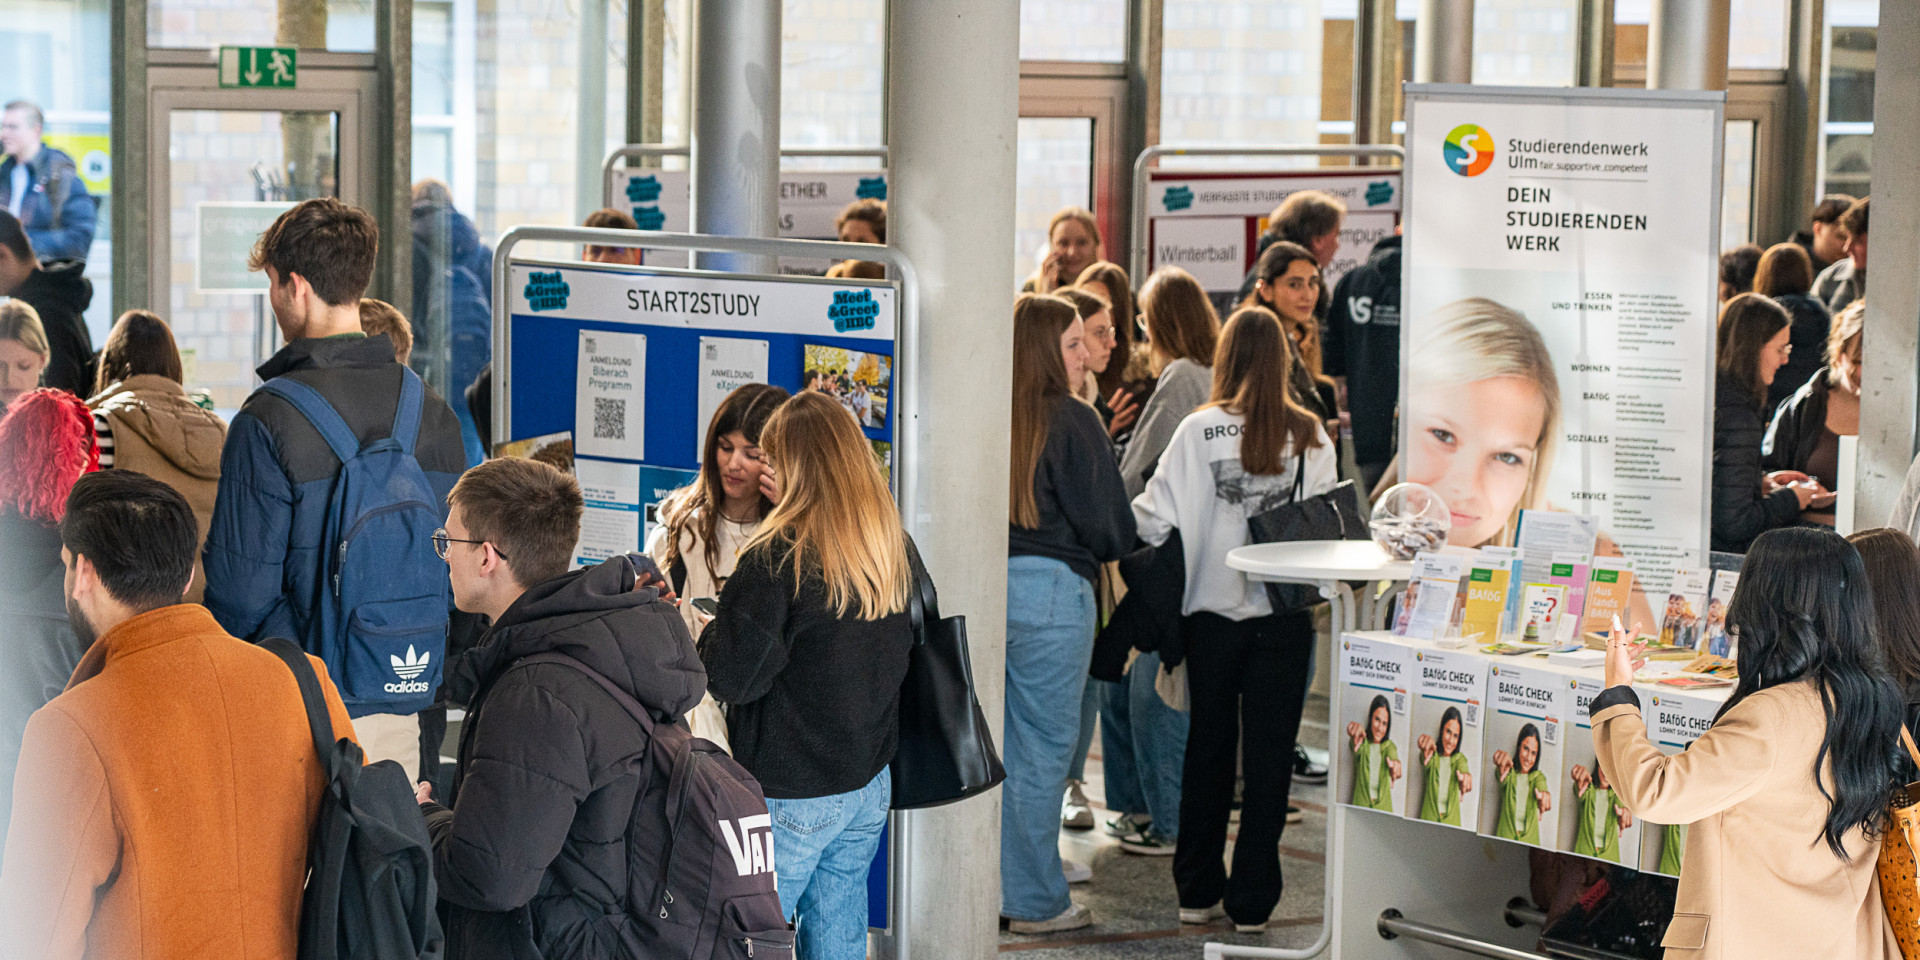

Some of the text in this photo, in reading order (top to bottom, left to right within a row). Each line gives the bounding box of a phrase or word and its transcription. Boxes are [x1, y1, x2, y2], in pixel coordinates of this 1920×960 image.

[1509, 138, 1648, 156] Studierendenwerk
[1508, 155, 1537, 168] Ulm
[780, 182, 827, 198] ETHER
[1508, 188, 1550, 203] DEIN
[1507, 211, 1647, 231] STUDIERENDEN
[1339, 228, 1386, 246] mpus
[1507, 236, 1559, 251] WERK
[1159, 246, 1236, 263] Winterball
[835, 290, 870, 304] Meet
[1585, 292, 1612, 300] ESSEN
[627, 289, 761, 318] START2STUDY
[829, 302, 878, 317] &Greet
[1552, 302, 1570, 310] UND
[1574, 302, 1612, 311] TRINKEN
[590, 356, 631, 366] ANMELDUNG
[1571, 364, 1610, 372] WOHNEN
[593, 366, 628, 378] Biberach
[711, 369, 754, 379] ANMELDUNG
[589, 377, 632, 391] Programm
[1567, 434, 1609, 443] SOZIALES
[1571, 492, 1607, 501] SERVICE
[1595, 586, 1612, 596] Aus
[1591, 608, 1616, 618] BAfö
[1350, 656, 1401, 673] BAföG CHECK
[1423, 668, 1474, 685] BAföG CHECK
[384, 680, 429, 694] adidas
[1499, 683, 1553, 702] BAföG CHECK
[1660, 713, 1711, 730] BAföG CHEC
